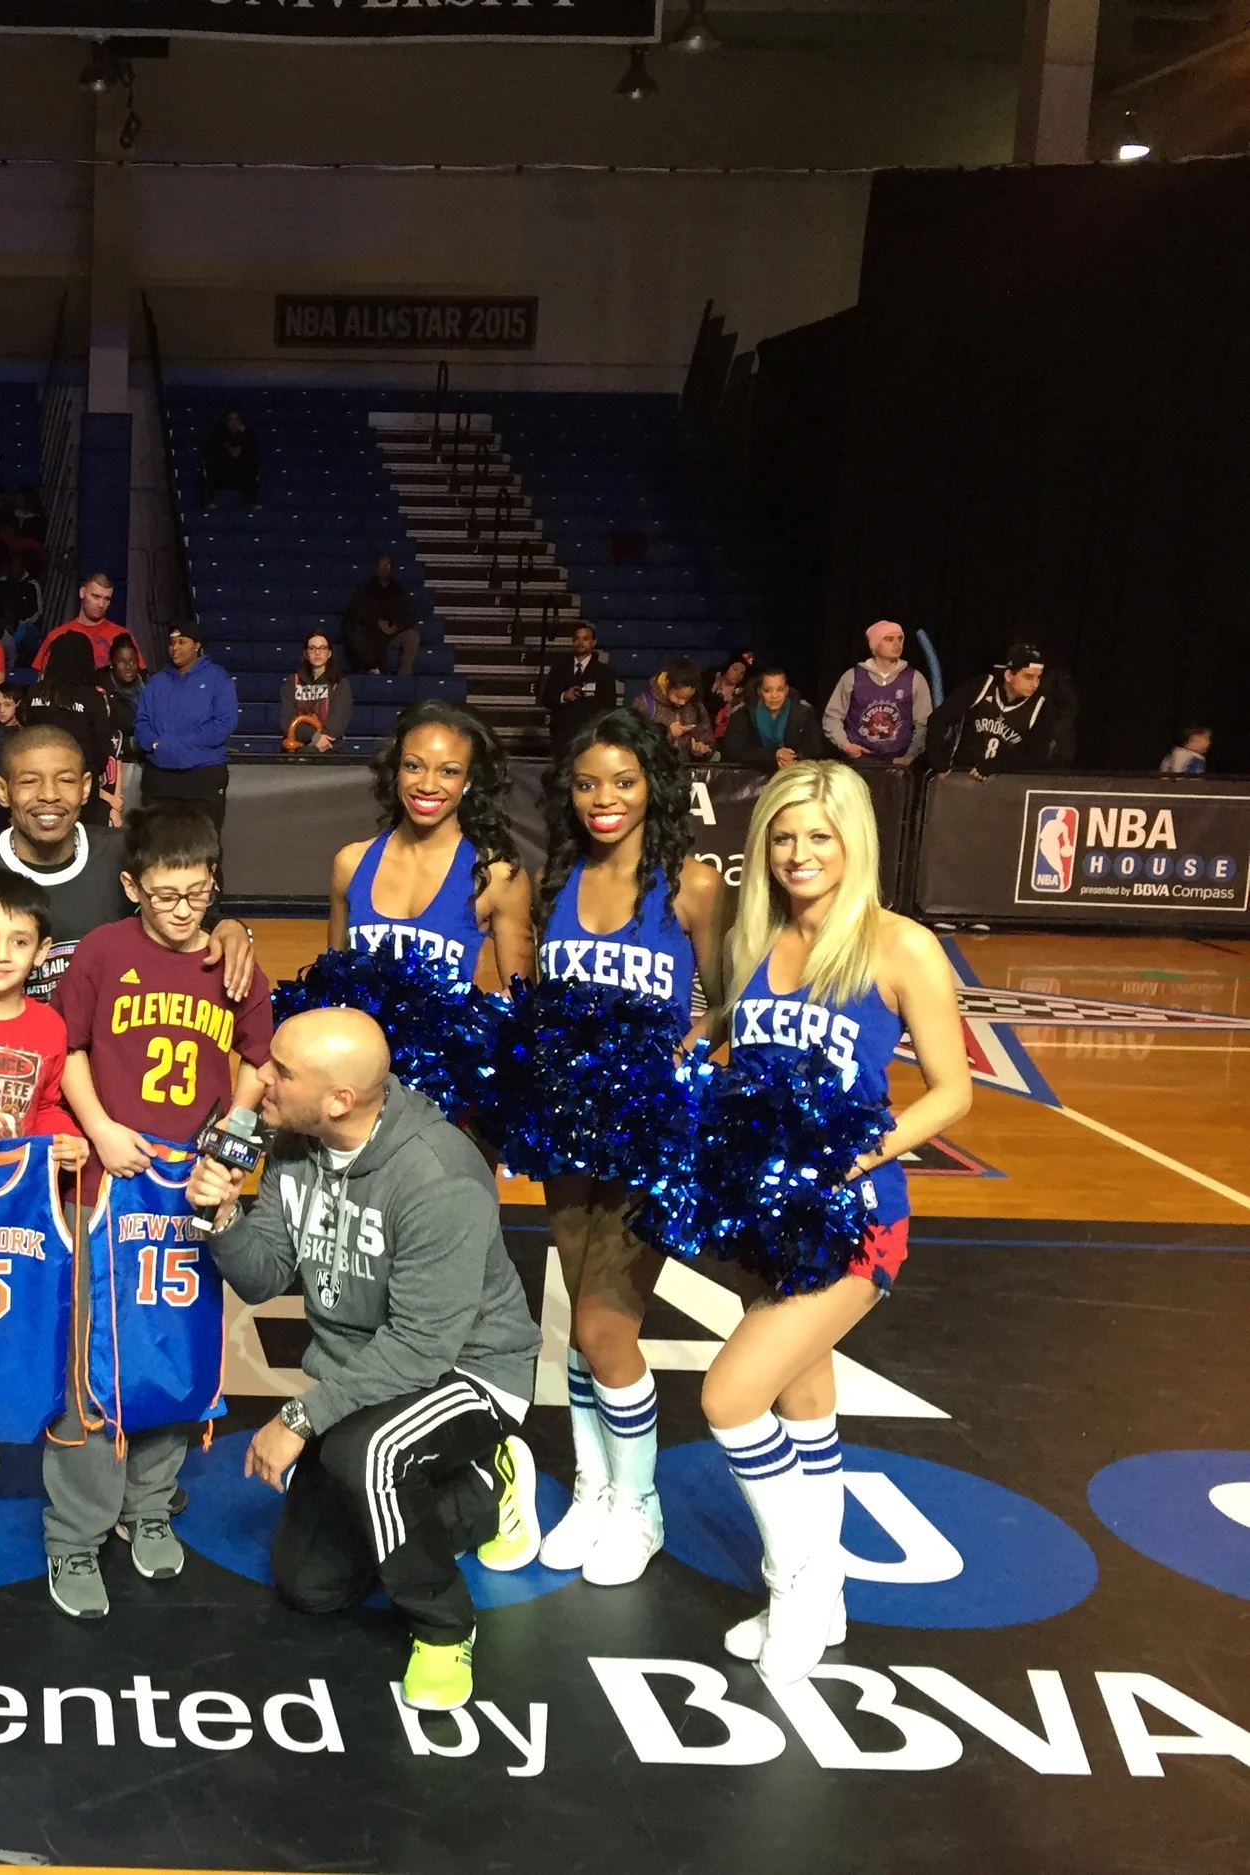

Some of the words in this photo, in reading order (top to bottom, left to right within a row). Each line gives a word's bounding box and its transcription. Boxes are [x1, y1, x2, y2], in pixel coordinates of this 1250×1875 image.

[284, 305, 337, 337] NBA
[467, 307, 527, 340] 2015
[974, 717, 1023, 745] BROOKLYN
[984, 737, 1000, 760] 8
[1085, 806, 1178, 850] NBA
[1036, 873, 1059, 887] NBA
[1089, 854, 1229, 879] HOUSE
[1080, 885, 1120, 897] presented
[1120, 886, 1131, 897] by
[1133, 883, 1170, 897] BBVA
[1172, 884, 1235, 901] Compass
[111, 991, 235, 1053] CLEVELAND
[731, 998, 860, 1072] IXERS
[141, 1036, 199, 1106] 23
[119, 1213, 170, 1243] NEW
[171, 1215, 206, 1242] YO
[136, 1245, 200, 1307] 15
[317, 1270, 341, 1294] NES
[390, 1680, 548, 1778] by
[587, 1656, 1250, 1778] BBVA
